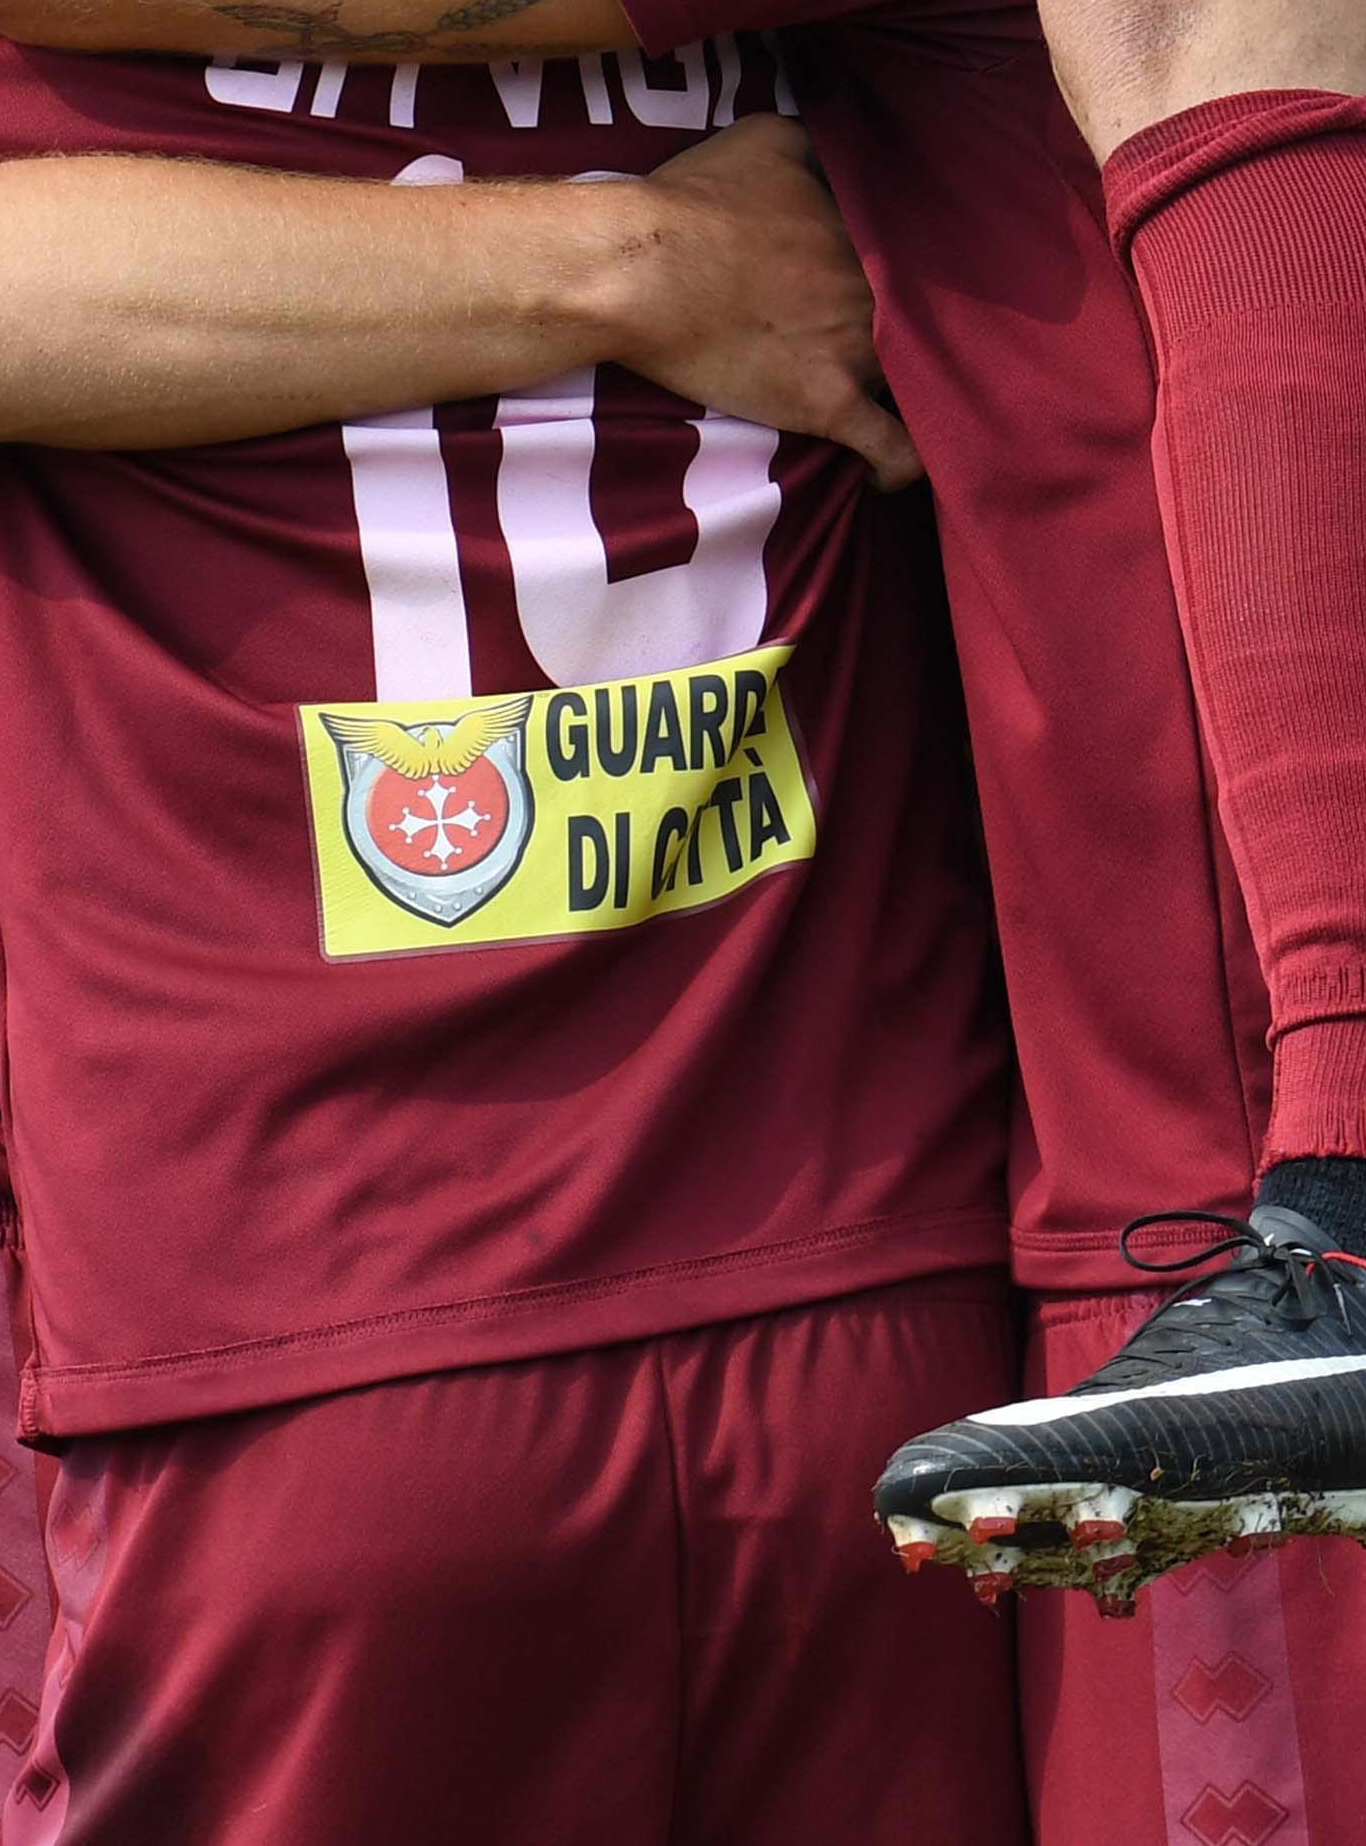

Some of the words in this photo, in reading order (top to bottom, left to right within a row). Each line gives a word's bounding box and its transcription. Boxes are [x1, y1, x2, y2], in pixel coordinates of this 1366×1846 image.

[338, 154, 782, 703] 10
[546, 666, 783, 782] GUARD
[567, 812, 631, 912] DI
